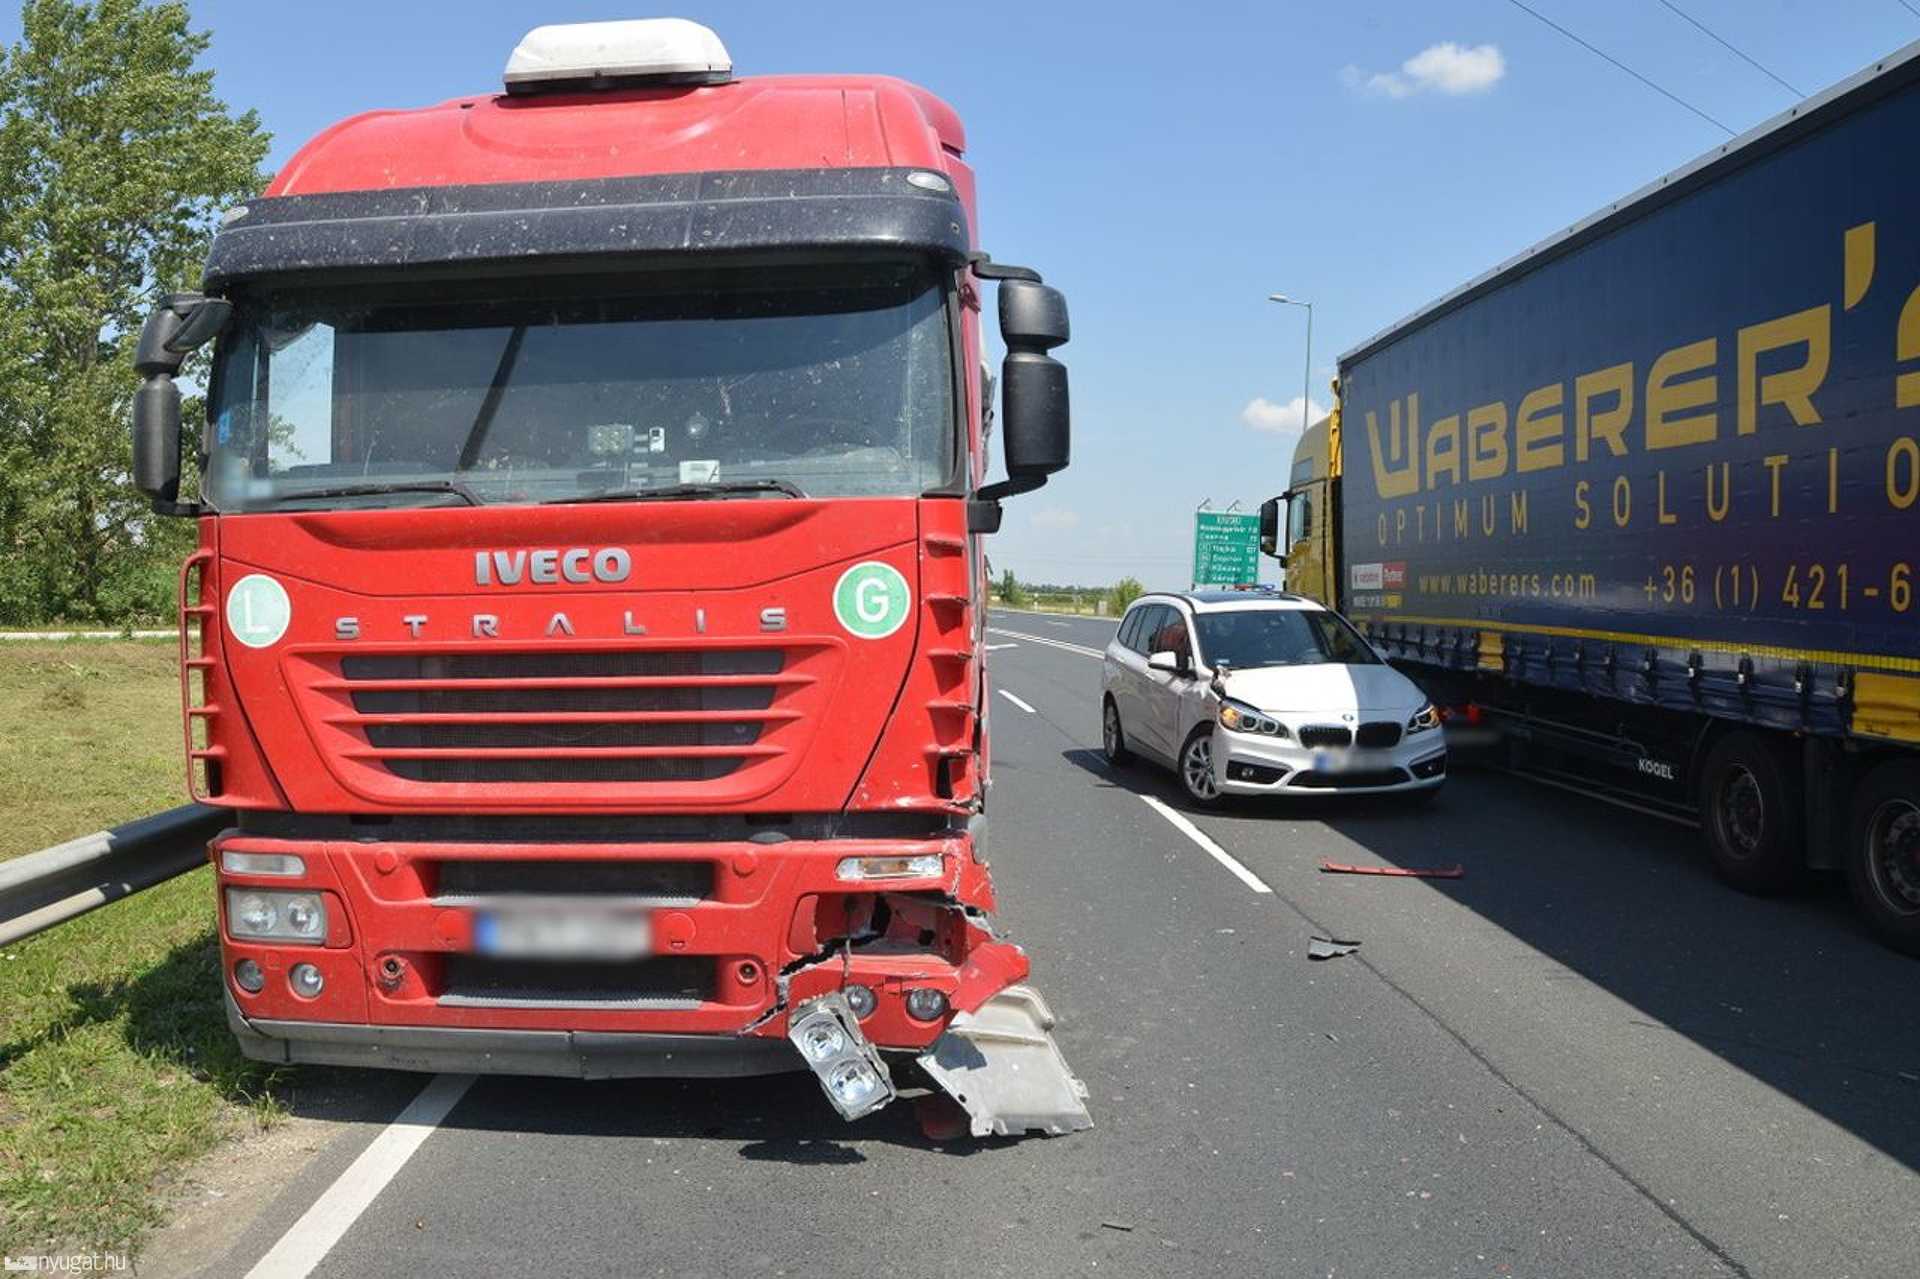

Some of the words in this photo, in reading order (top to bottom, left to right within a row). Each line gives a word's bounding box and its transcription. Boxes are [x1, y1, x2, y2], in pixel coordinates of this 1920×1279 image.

[1365, 221, 1920, 498] WABERER'
[1377, 489, 1528, 546] OPTIMUM
[1574, 436, 1920, 529] SOLUTIO
[474, 548, 632, 585] IVECO
[1419, 567, 1597, 598] www.waberers.com
[1643, 564, 1695, 603] +36
[1714, 563, 1760, 611] (1)
[1782, 562, 1912, 613] 421-6
[244, 589, 272, 634] L
[854, 578, 890, 623] G
[335, 608, 787, 640] STRALIS
